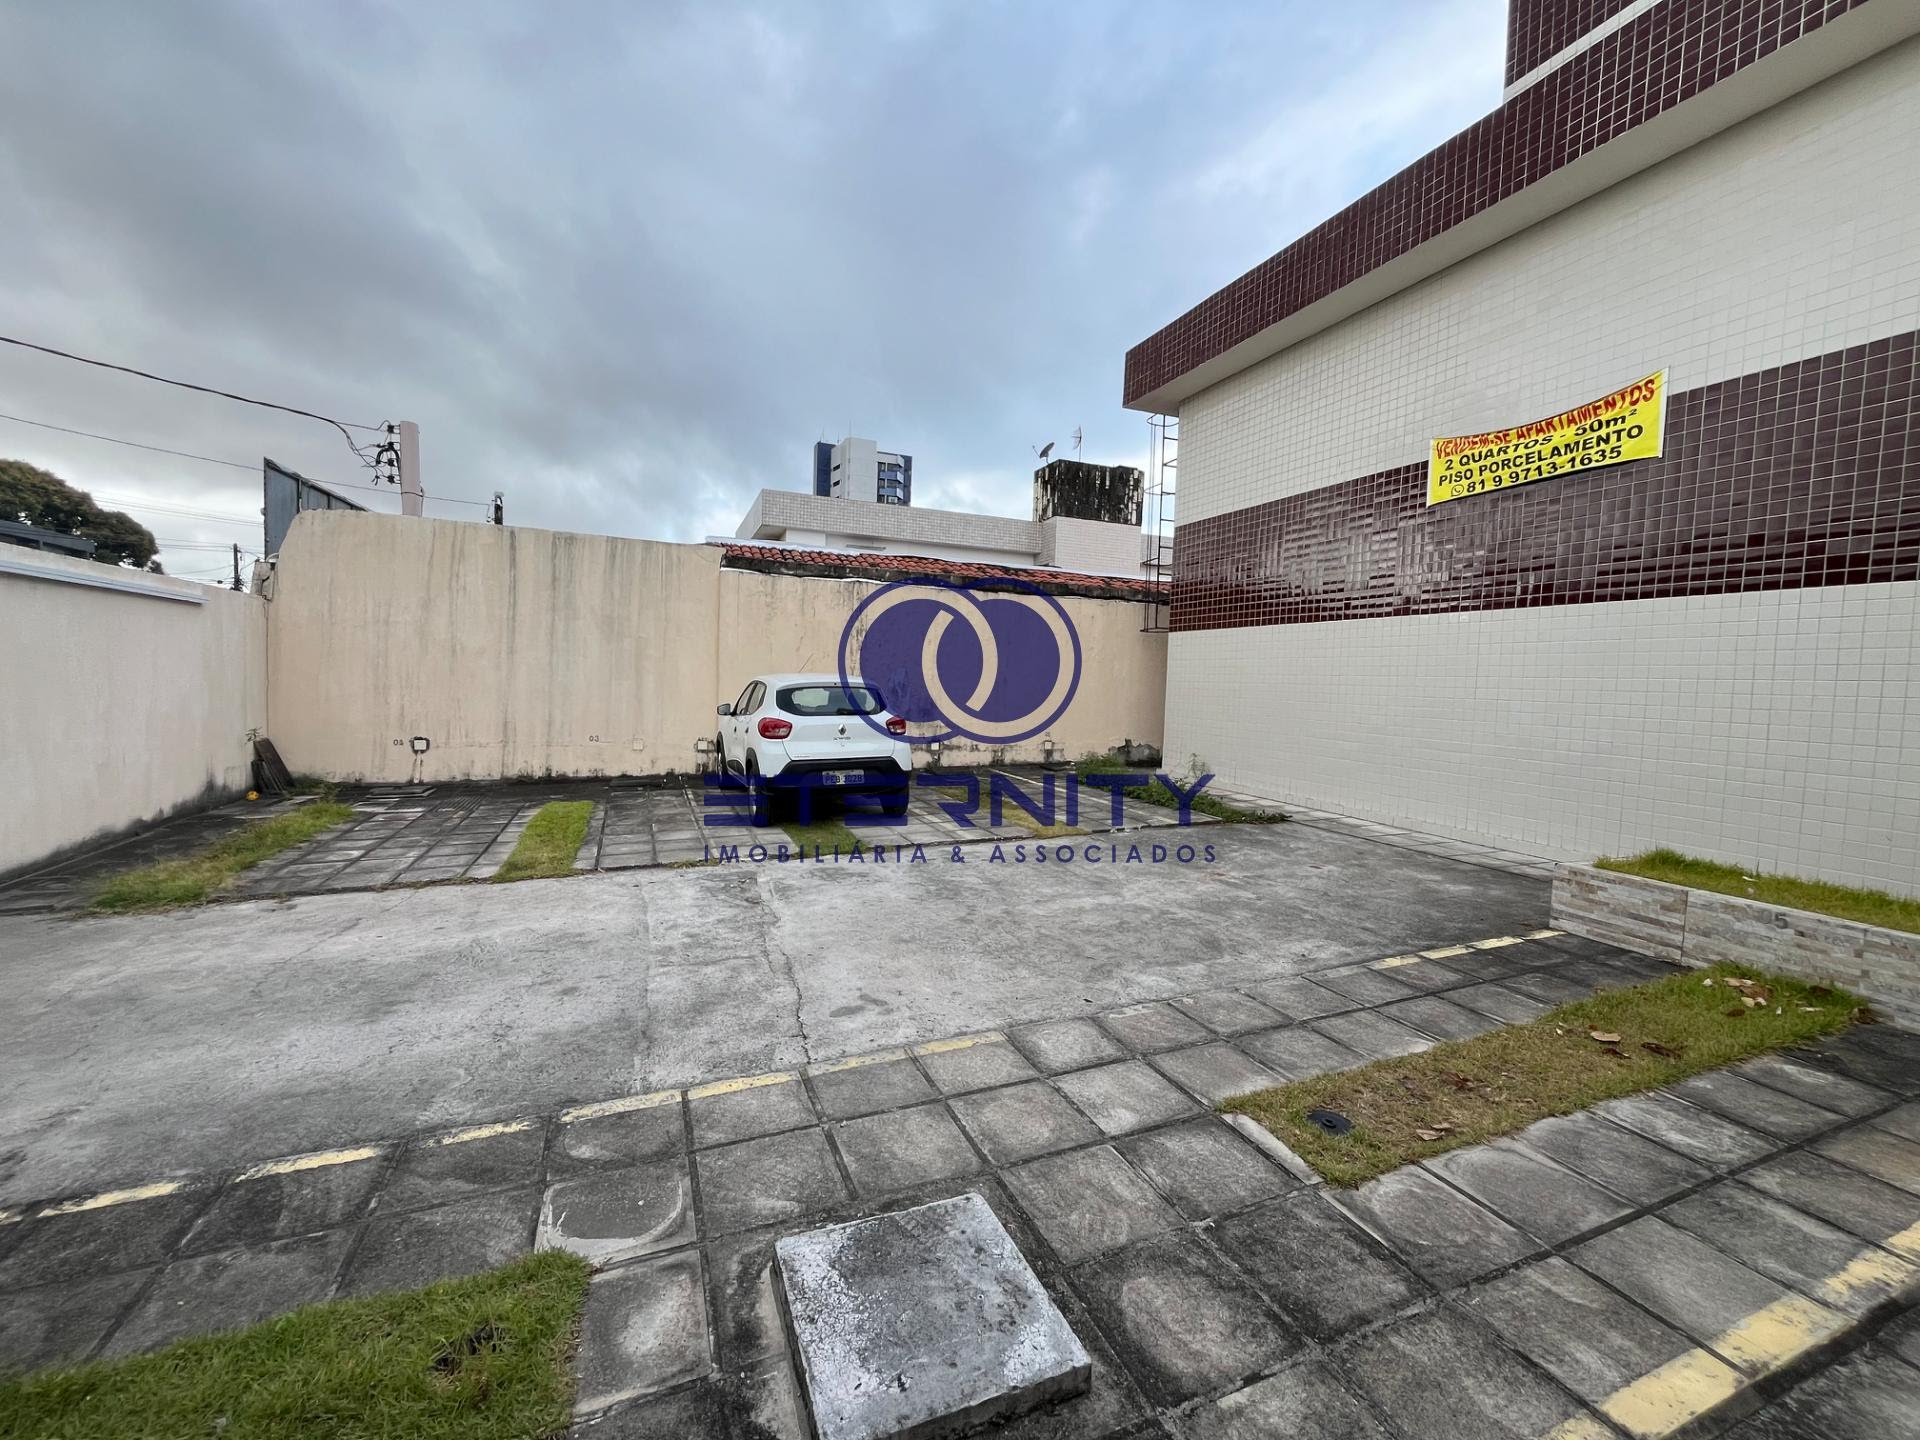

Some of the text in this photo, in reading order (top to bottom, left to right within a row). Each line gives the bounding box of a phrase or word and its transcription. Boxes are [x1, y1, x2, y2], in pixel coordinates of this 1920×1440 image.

[1516, 379, 1655, 441] APARTAMENTOS
[1439, 424, 1643, 486] PISO PORCELAMENTO
[1445, 459, 1454, 471] 2
[1459, 435, 1554, 466] QUARTOS
[1466, 445, 1622, 493] 81 9 9713-1635
